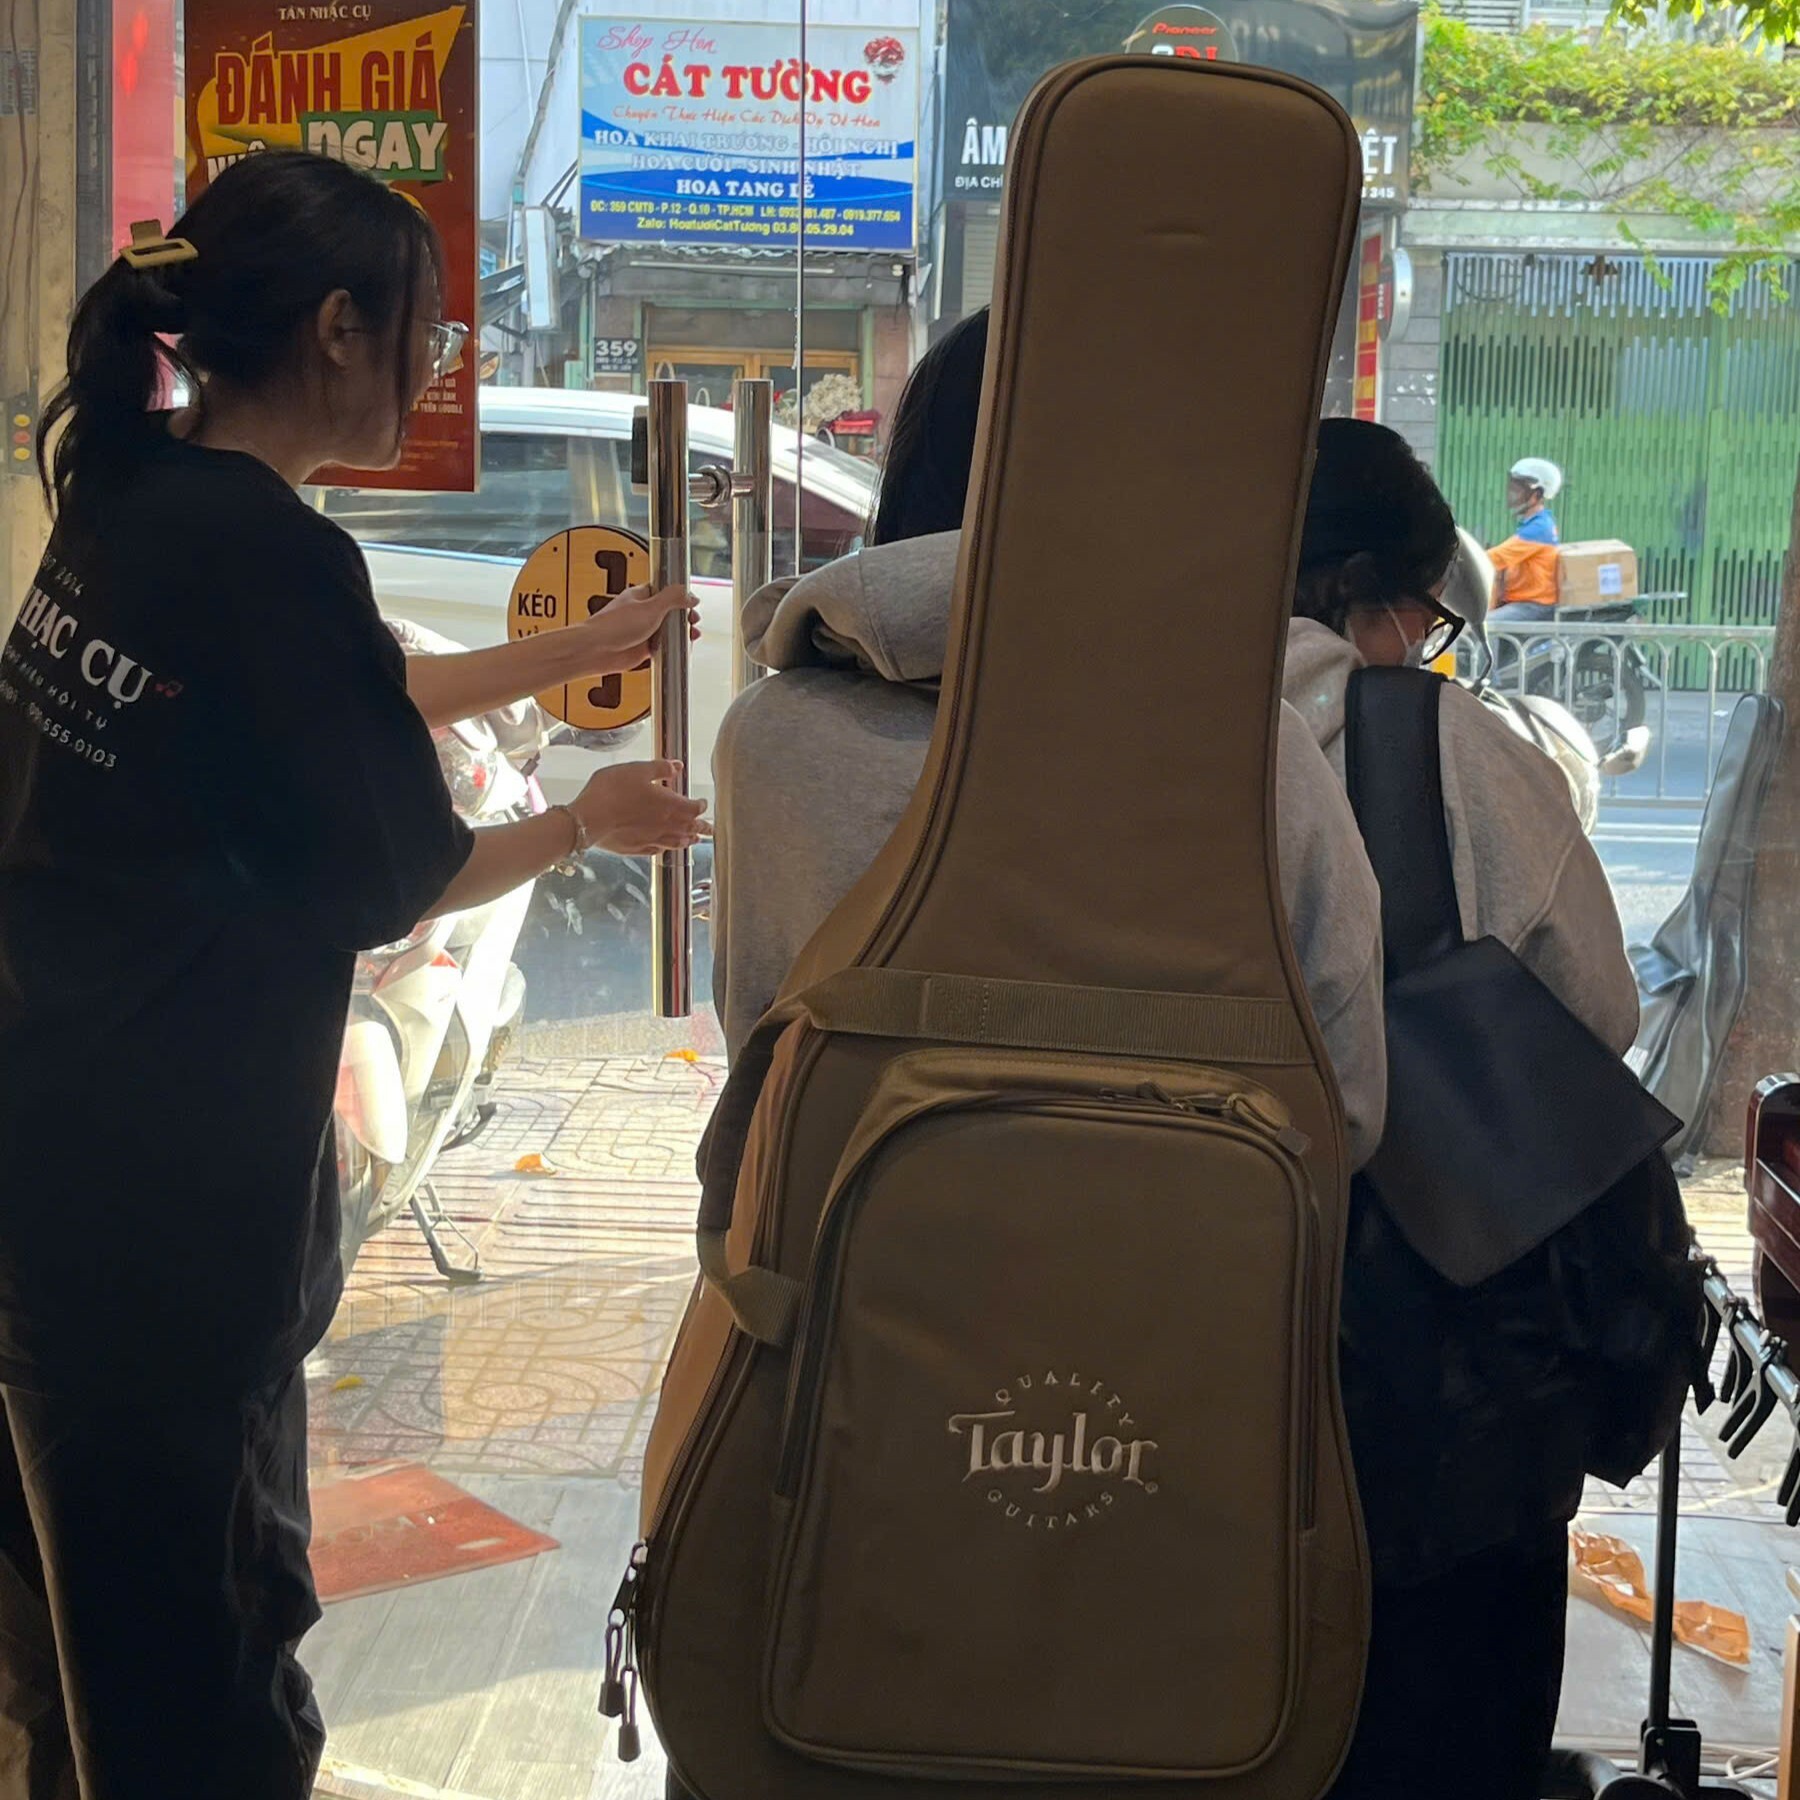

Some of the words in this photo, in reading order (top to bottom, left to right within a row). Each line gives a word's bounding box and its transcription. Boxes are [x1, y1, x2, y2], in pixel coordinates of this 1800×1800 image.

[310, 5, 348, 22] NHẠC
[352, 5, 371, 21] CỤ
[1152, 22, 1217, 35] Pioneer
[597, 24, 654, 58] Shop
[662, 26, 719, 54] Hoa
[216, 31, 341, 125] ĐÁNH
[361, 30, 439, 112] GIÁ
[623, 53, 711, 98] CÁT
[722, 58, 872, 104] TƯỜNG
[308, 120, 448, 172] NGAY
[594, 129, 639, 147] HOA
[643, 130, 697, 149] KHAI
[846, 138, 898, 160] NGHỊ
[961, 118, 1008, 166] ÂM
[632, 153, 675, 171] HOA
[747, 159, 798, 176] SINH
[803, 157, 860, 181] NHẬT
[676, 178, 721, 196] HOA
[725, 180, 784, 198] TANG
[955, 176, 979, 191] ĐỊA
[636, 216, 665, 229] Zalo:
[595, 340, 638, 357] 359
[517, 588, 557, 619] KÉO
[80, 638, 154, 710] CỤ
[995, 1370, 1135, 1427] QUALITY
[948, 1410, 1159, 1492] Taylor
[987, 1488, 1114, 1529] GUITARS
